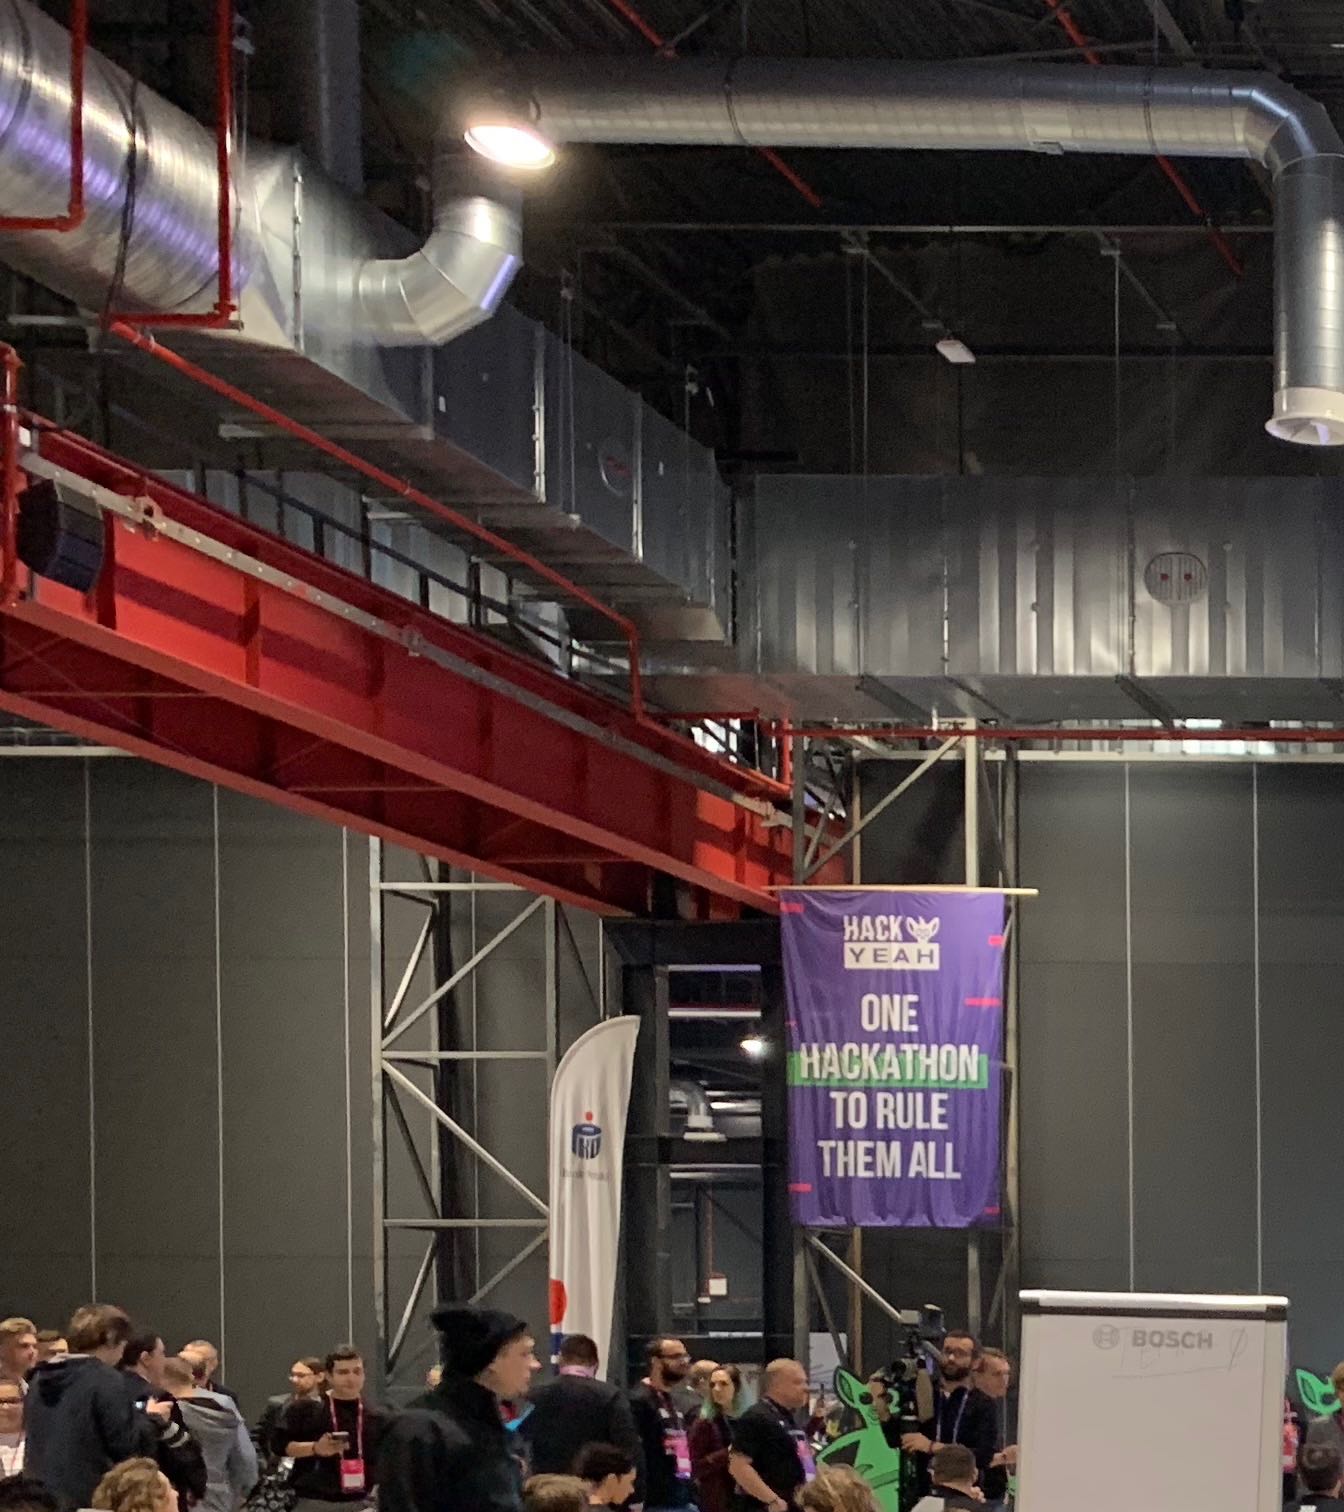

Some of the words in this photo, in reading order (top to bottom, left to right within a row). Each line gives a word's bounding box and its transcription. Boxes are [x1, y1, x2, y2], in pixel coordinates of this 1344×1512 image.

[843, 915, 903, 942] HACK
[849, 948, 934, 964] YEAH
[861, 993, 919, 1032] ONE
[800, 1042, 979, 1082] HACKATHON
[829, 1091, 867, 1130] TO
[876, 1092, 949, 1130] RULE
[817, 1140, 901, 1179] THEM
[908, 1141, 962, 1180] ALL
[1131, 1329, 1214, 1350] BOSCH
